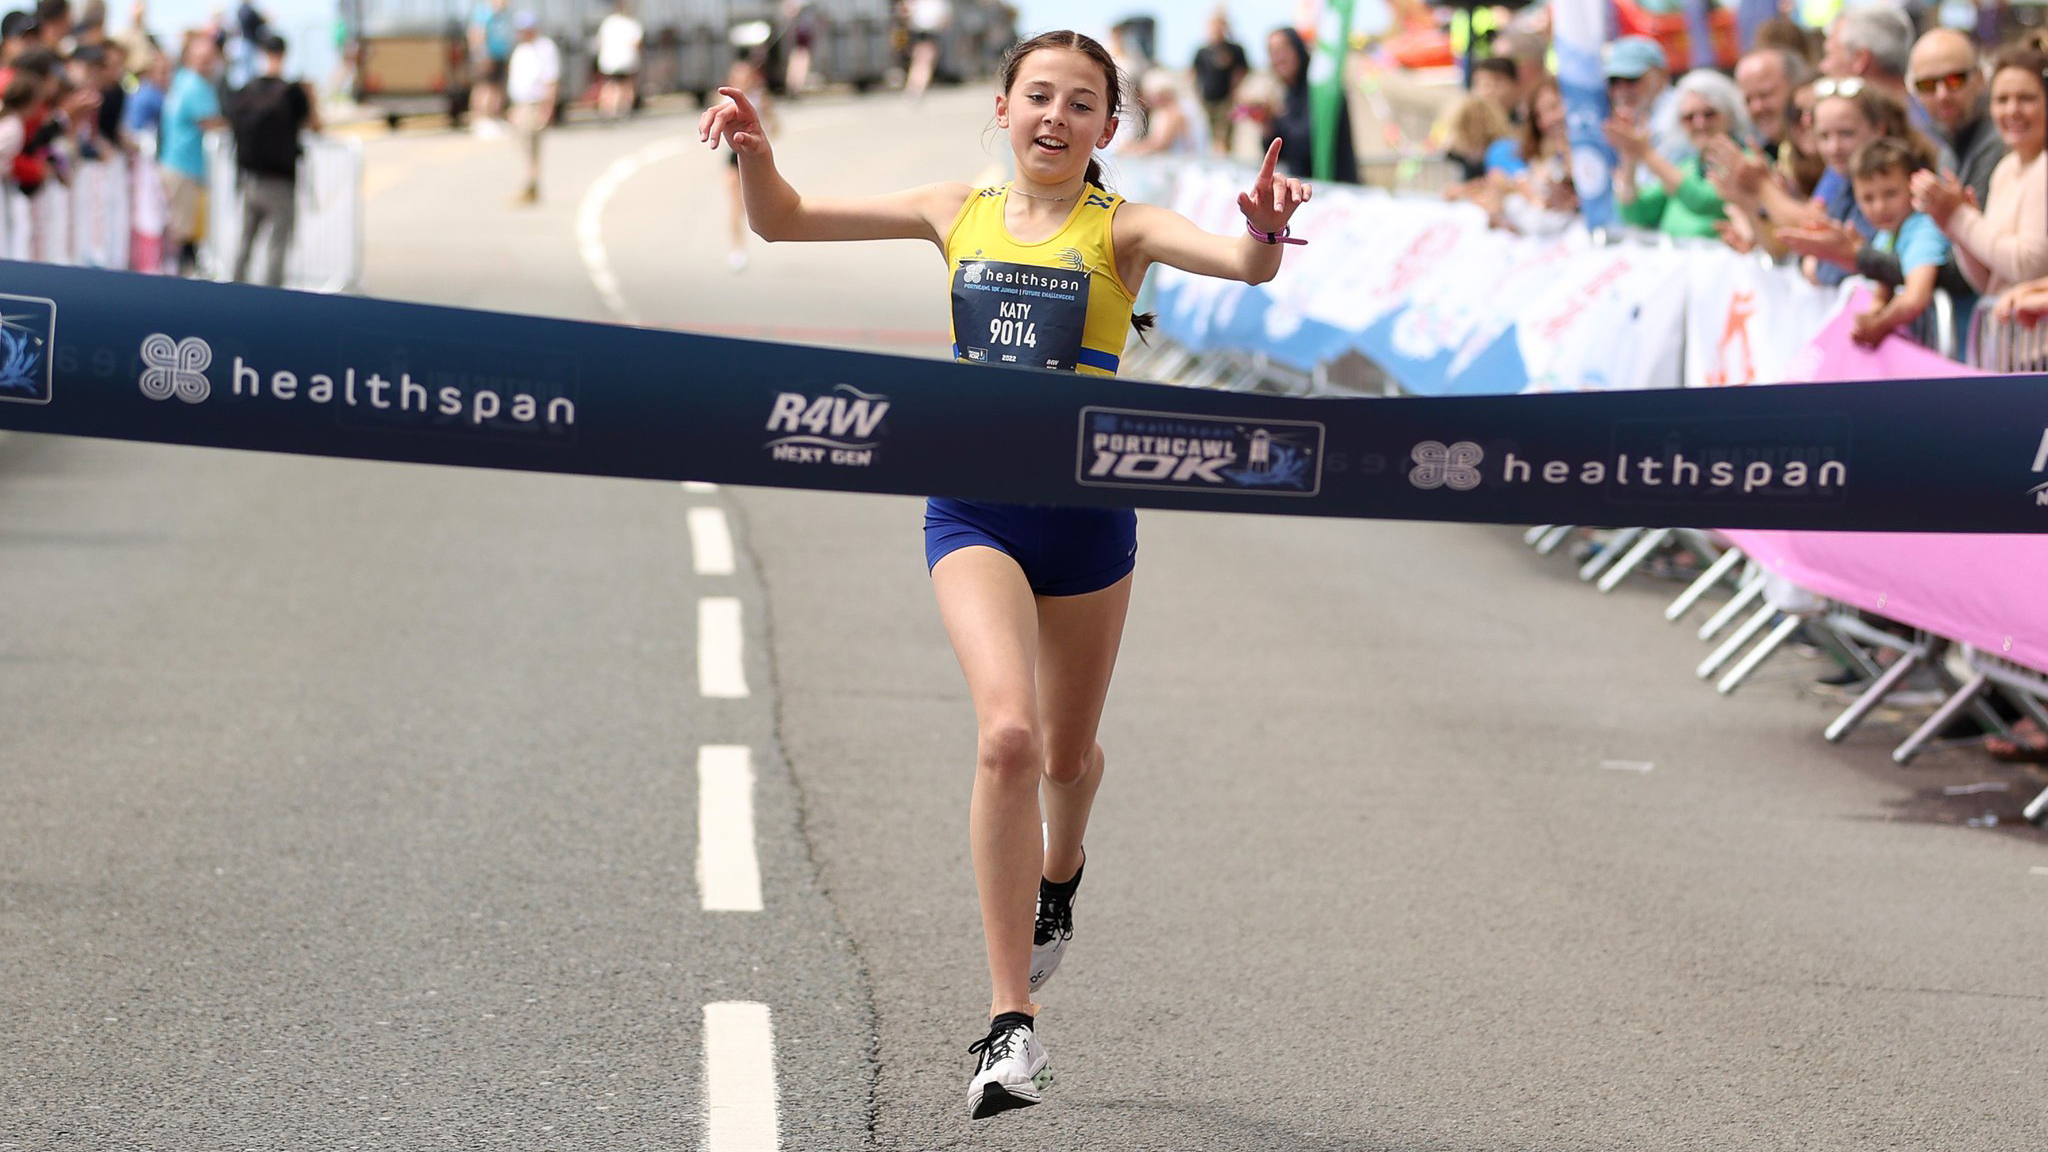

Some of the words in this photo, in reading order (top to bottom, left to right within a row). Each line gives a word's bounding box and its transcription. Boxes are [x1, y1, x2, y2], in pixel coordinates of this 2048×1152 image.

[986, 269, 1079, 291] healthspan
[1000, 287, 1018, 295] JUNIOR
[1022, 289, 1041, 298] FUTURE
[1041, 292, 1075, 301] CHALLENGERS
[1000, 301, 1032, 320] KATY
[989, 319, 1037, 348] 9014
[1001, 354, 1017, 363] 2022
[232, 356, 576, 426] healthspan
[766, 391, 891, 438] R4W
[772, 443, 826, 463] NEXT
[830, 449, 873, 467] GEN
[1093, 432, 1238, 460] PORTHCAWL
[1088, 450, 1237, 484] 10K
[1502, 453, 1848, 492] healthspan
